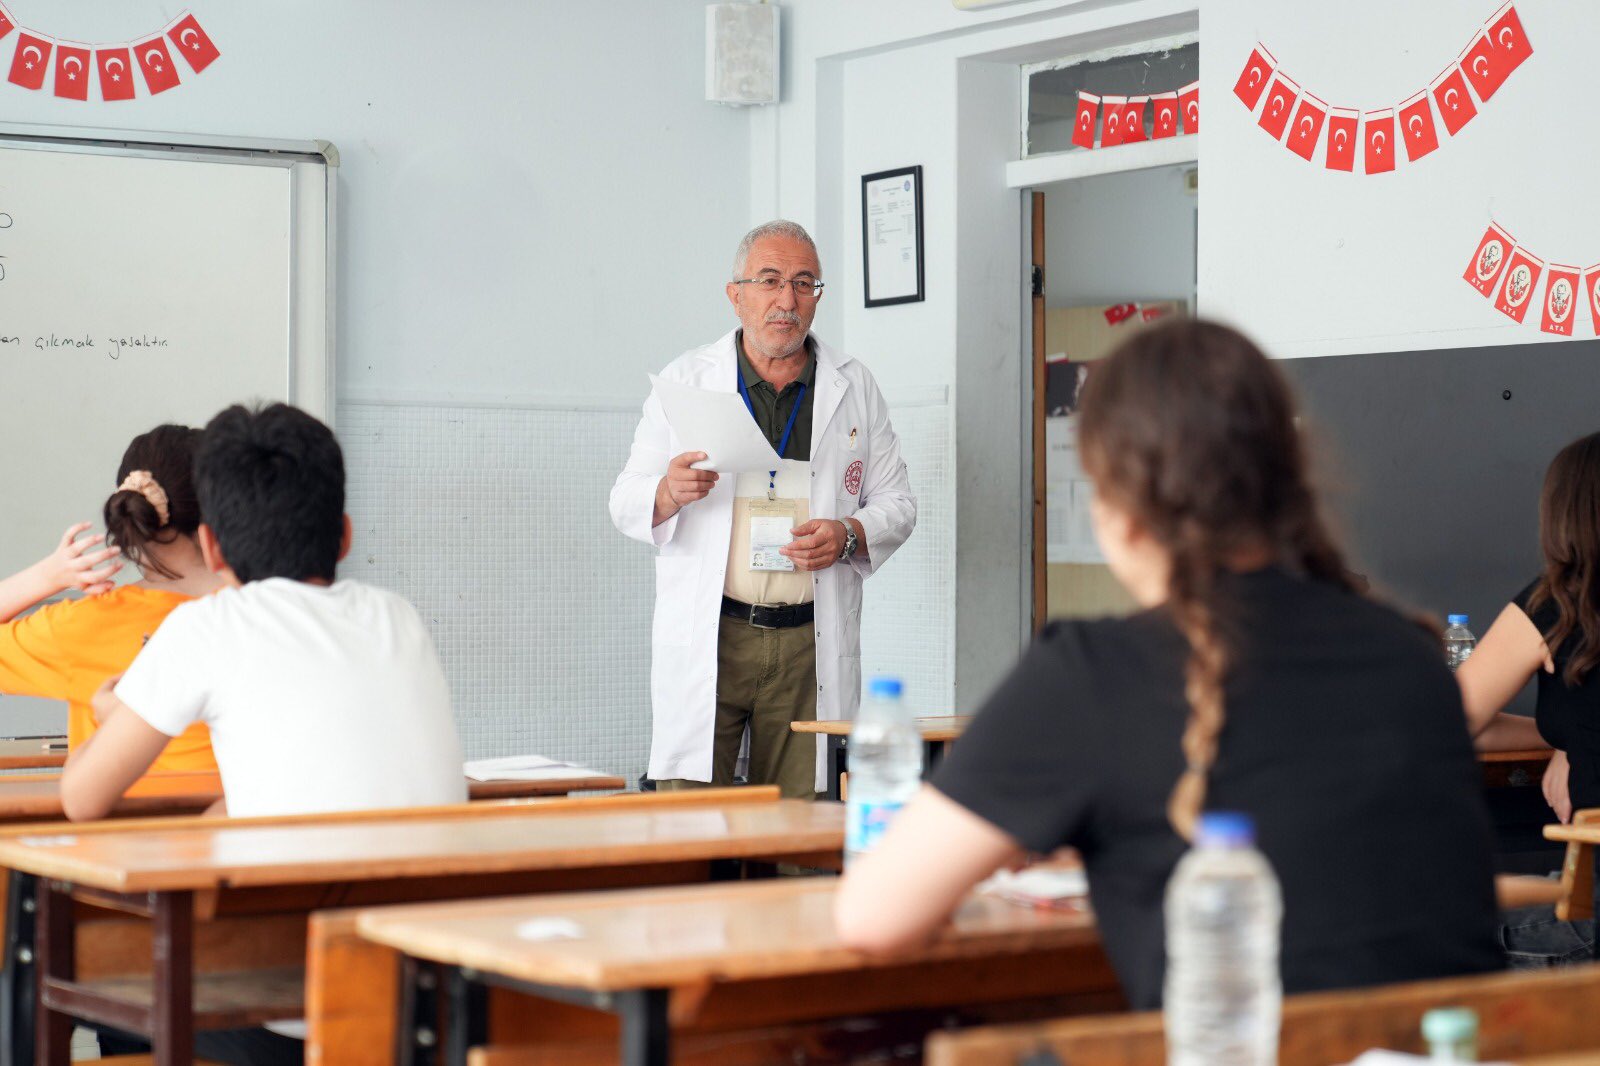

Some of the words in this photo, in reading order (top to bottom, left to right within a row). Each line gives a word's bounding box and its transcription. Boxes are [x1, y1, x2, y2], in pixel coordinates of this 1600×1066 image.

[1471, 277, 1485, 291] ATA
[1502, 305, 1516, 317] ATA
[1549, 323, 1564, 332] ATA
